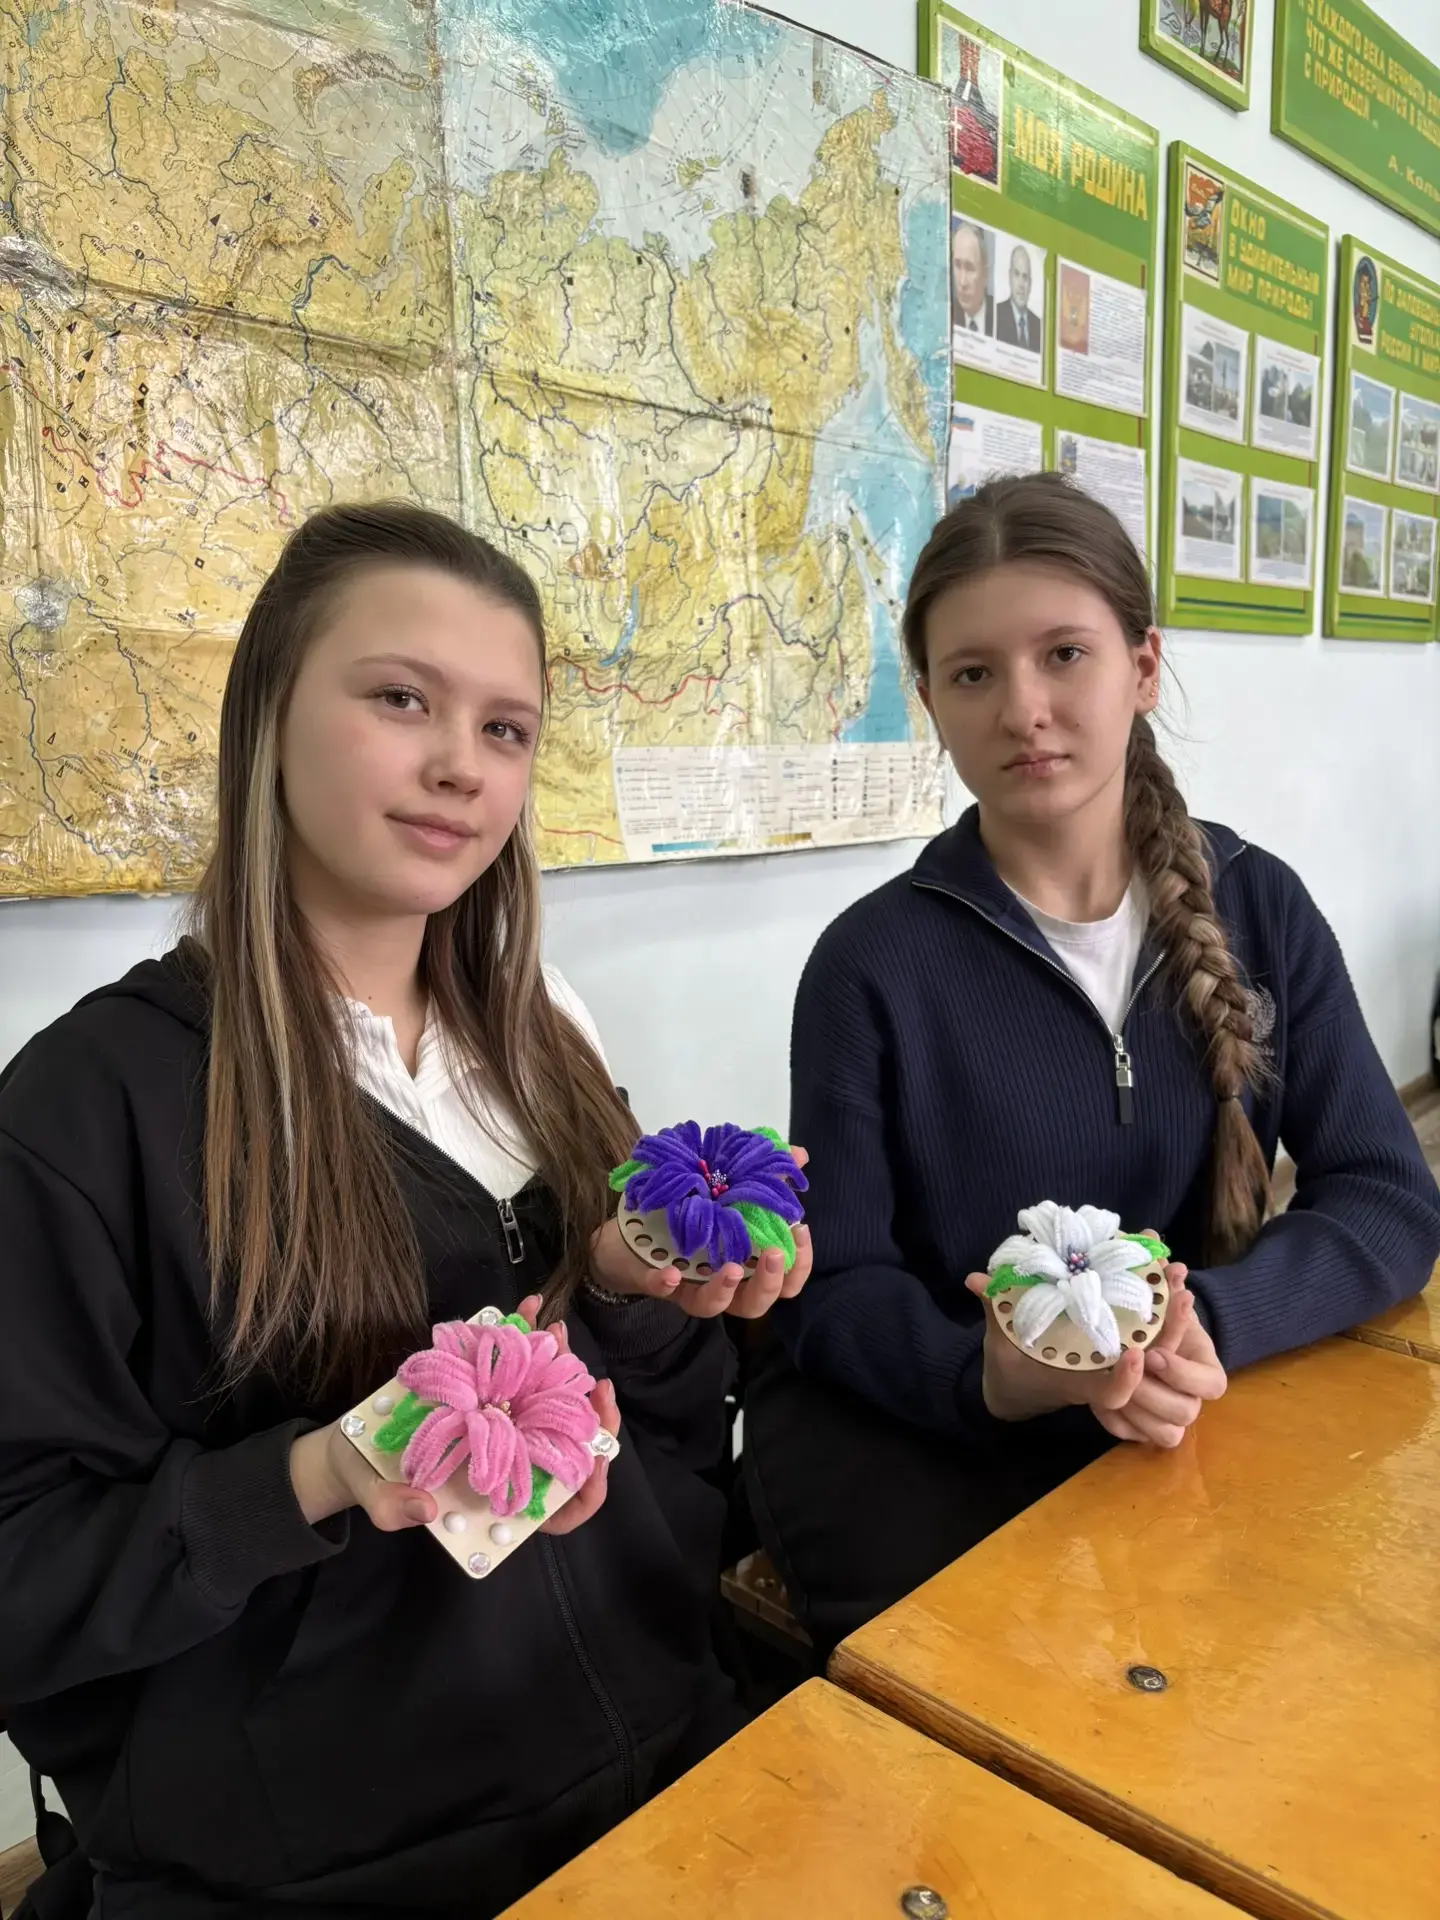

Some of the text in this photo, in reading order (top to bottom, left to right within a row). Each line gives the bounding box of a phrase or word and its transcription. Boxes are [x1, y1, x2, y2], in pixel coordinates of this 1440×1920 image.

[1304, 52, 1311, 79] С
[1305, 17, 1325, 58] ЧТО
[1327, 38, 1344, 73] ЖЕ
[1, 131, 36, 177] ЯРОСЛАВЛЬ
[1013, 103, 1149, 221] МОЯ РОДИНА
[1230, 198, 1266, 241] ОКНО
[1228, 231, 1237, 258] В
[1226, 263, 1314, 321] МИР ПРИРОДЫ
